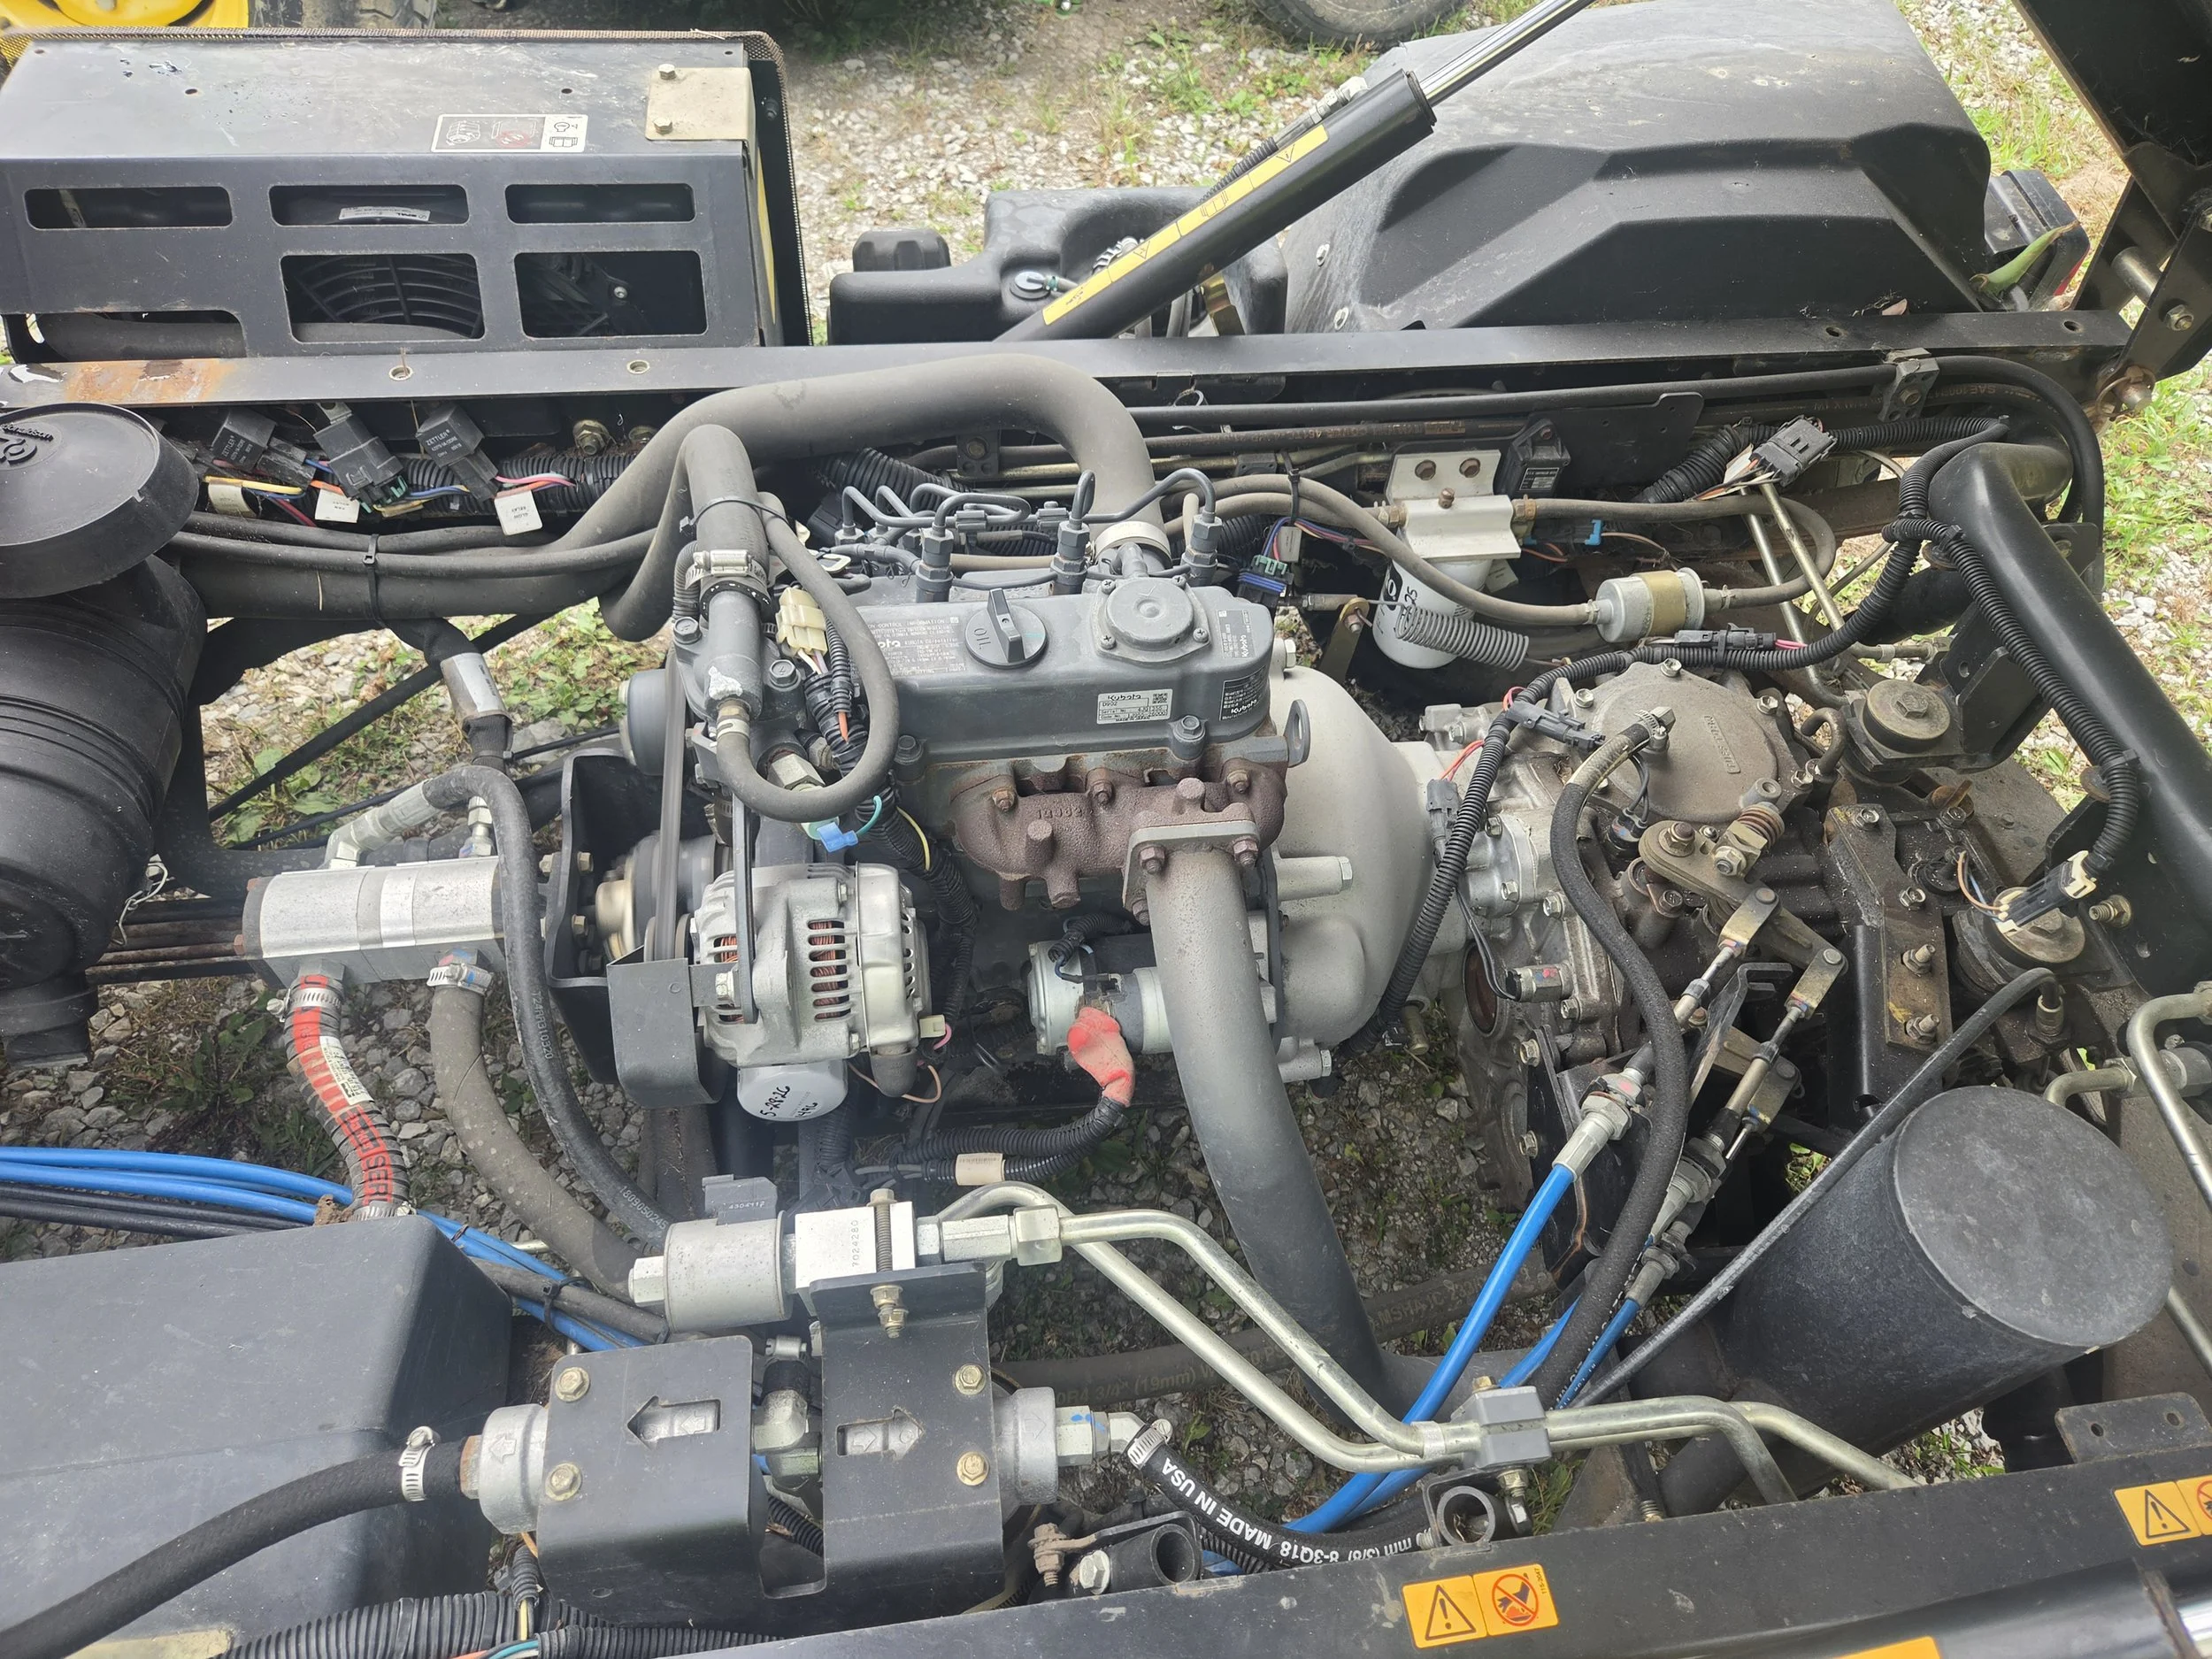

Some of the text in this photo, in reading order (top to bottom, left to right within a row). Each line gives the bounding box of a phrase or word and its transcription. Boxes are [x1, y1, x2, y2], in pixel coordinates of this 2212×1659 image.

[973, 627, 992, 650] OIL
[1231, 699, 1257, 714] Kubota
[1161, 1457, 1195, 1493] USA
[1194, 1490, 1215, 1516] IN
[1216, 1507, 1273, 1550] MADE
